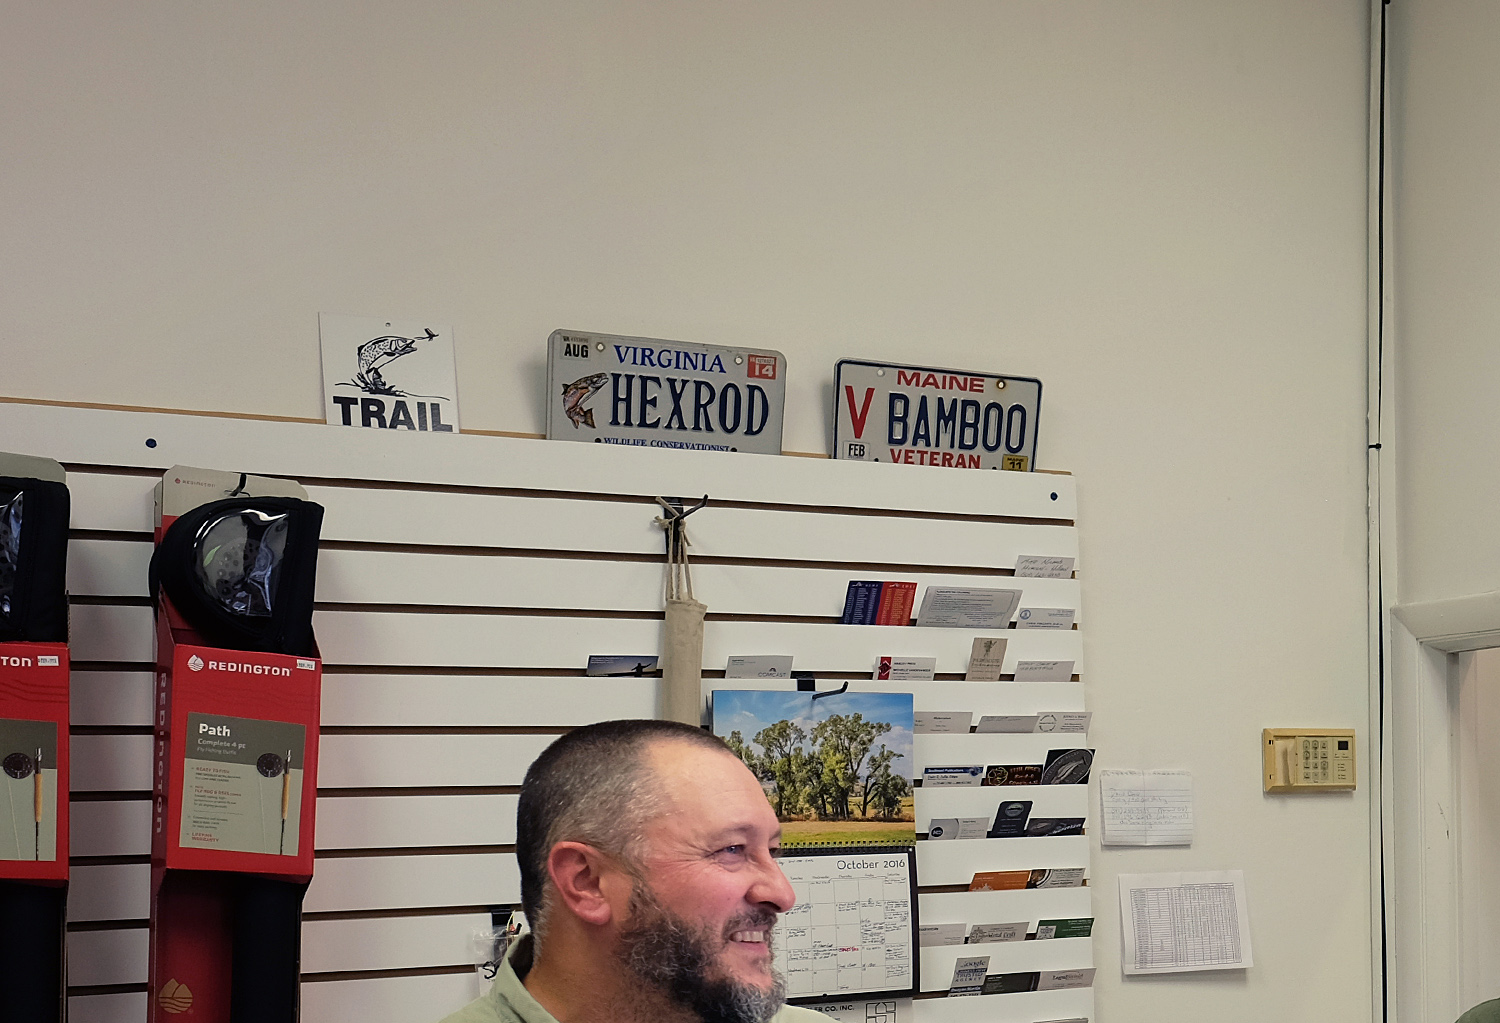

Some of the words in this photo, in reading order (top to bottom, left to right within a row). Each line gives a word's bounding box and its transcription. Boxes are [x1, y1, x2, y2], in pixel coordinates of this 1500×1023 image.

[564, 343, 589, 358] AUG
[613, 345, 726, 373] VIRGINIA
[897, 370, 985, 393] MAINE
[609, 372, 770, 436] HEXROD
[845, 385, 875, 439] V
[333, 396, 453, 432] TRAIL
[888, 391, 1027, 454] BAMBOO
[604, 437, 647, 447] WILDLIFE
[848, 444, 866, 457] FEB
[890, 448, 981, 469] VETERAN
[208, 661, 292, 677] REDINGTON
[199, 723, 231, 737] Path
[197, 738, 230, 748] Complete
[837, 859, 879, 870] October
[884, 859, 906, 869] 2016
